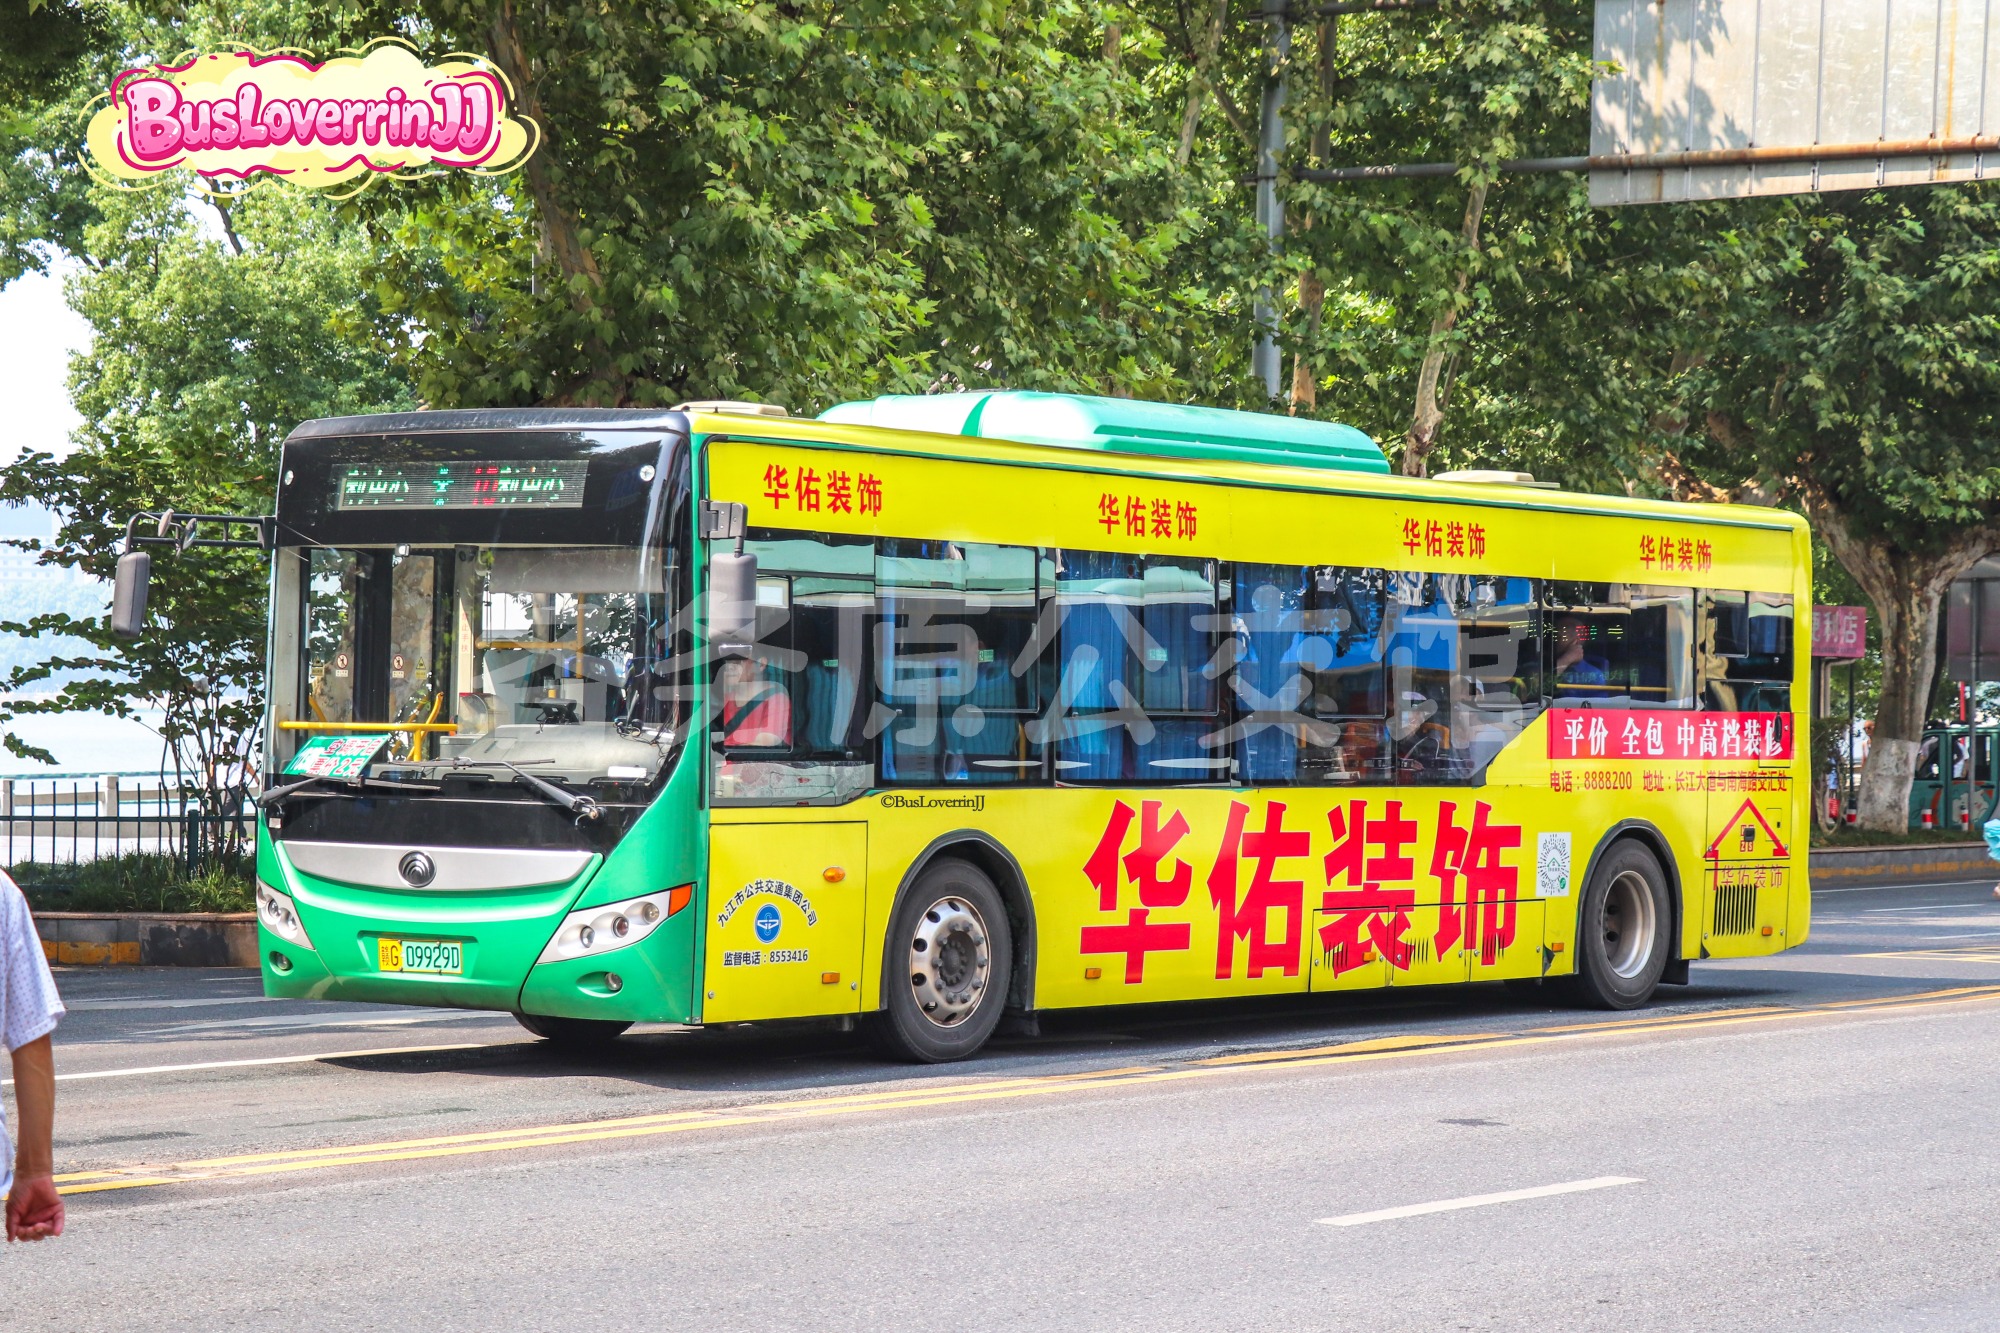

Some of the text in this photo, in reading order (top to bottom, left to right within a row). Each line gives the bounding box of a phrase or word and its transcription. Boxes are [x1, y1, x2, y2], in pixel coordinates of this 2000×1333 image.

[762, 463, 884, 517] 华佑装饰
[1098, 493, 1198, 541] 华佑装饰
[1402, 517, 1486, 559] 华佑装饰
[1639, 534, 1713, 574] 华佑装饰
[1563, 716, 1784, 757] 平价 全包 中高档装修
[1079, 798, 1523, 985] 华佑装饰
[1720, 864, 1783, 888] 华佑装饰
[717, 879, 818, 927] 九江市公共交通集团公司
